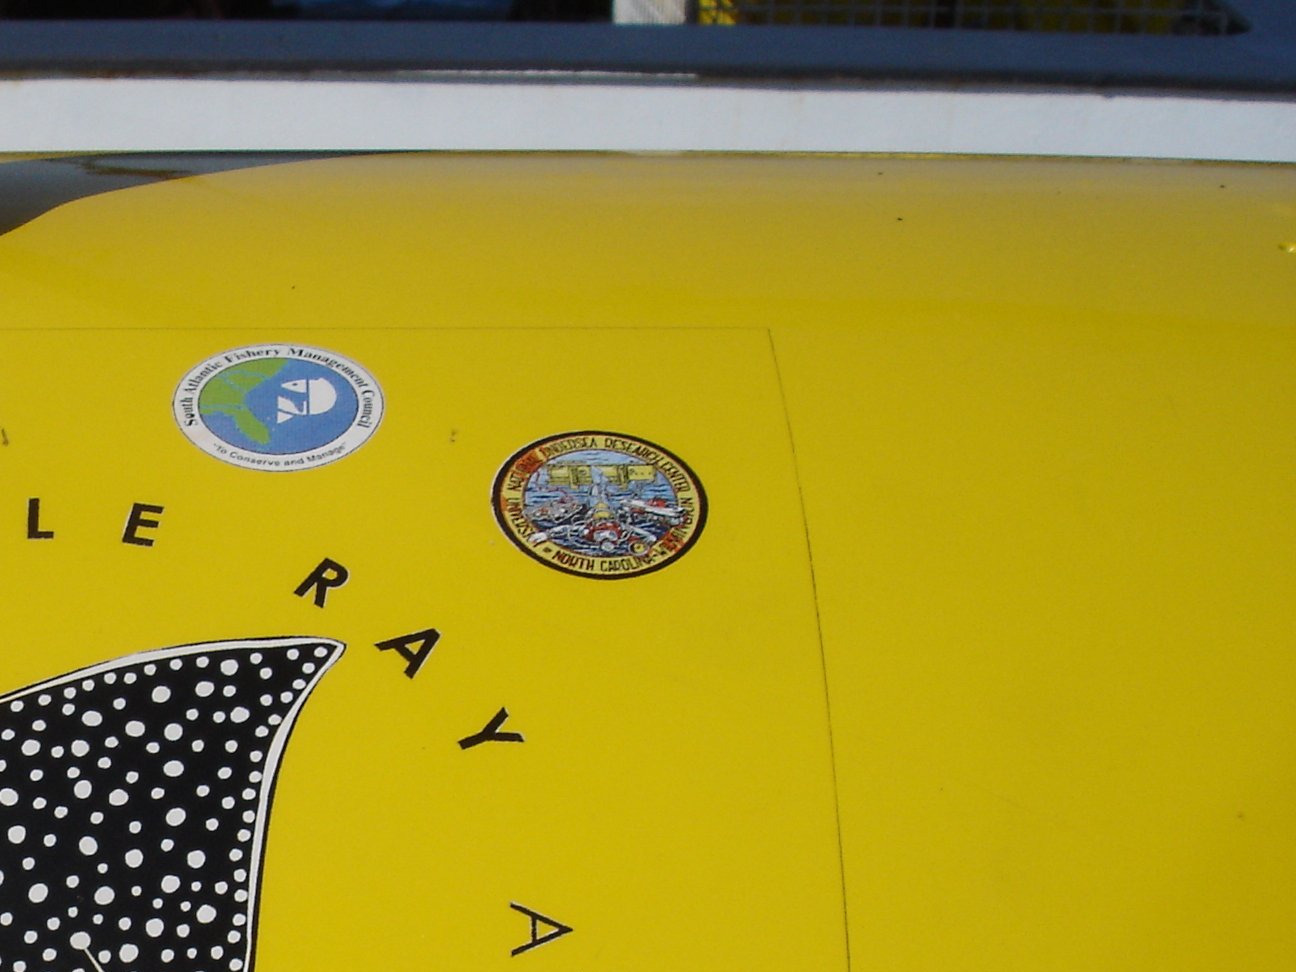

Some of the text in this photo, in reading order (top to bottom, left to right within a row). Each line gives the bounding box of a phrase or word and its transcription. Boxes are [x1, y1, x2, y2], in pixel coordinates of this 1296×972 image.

[183, 347, 377, 429] South Atlantic Fishery Management Council
[229, 451, 281, 468] Conserve
[283, 457, 305, 467] and
[551, 549, 595, 572] NORTH
[293, 557, 525, 753] RAY
